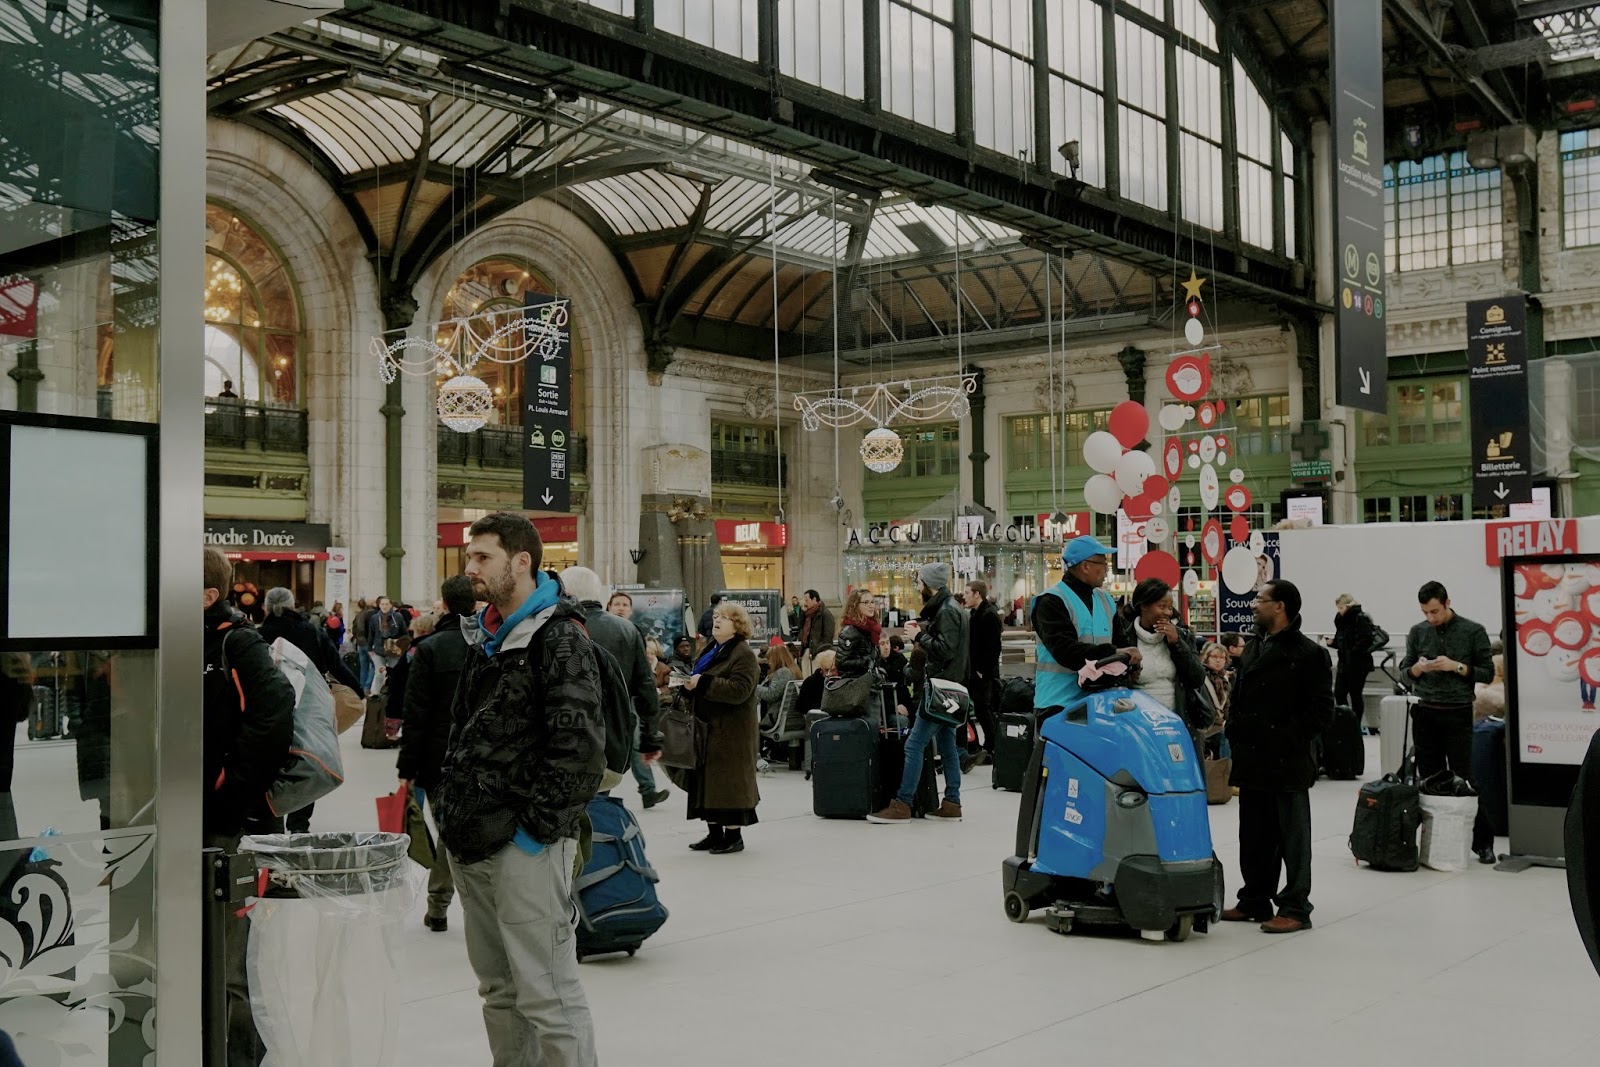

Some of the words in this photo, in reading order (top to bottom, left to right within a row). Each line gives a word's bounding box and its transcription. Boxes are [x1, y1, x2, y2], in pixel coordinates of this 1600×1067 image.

[1338, 158, 1362, 180] Location
[1362, 172, 1383, 189] voitures
[1480, 326, 1512, 335] Consignes
[1490, 364, 1521, 372] rencontre
[537, 388, 559, 399] Sortie
[535, 405, 549, 413] Louis
[549, 408, 568, 416] Armand
[1481, 461, 1521, 472] Billetterie
[252, 529, 295, 547] Dorée
[1526, 722, 1562, 732] JOYEUX
[1526, 732, 1538, 742] ET
[1540, 733, 1590, 743] MEILLEURS
